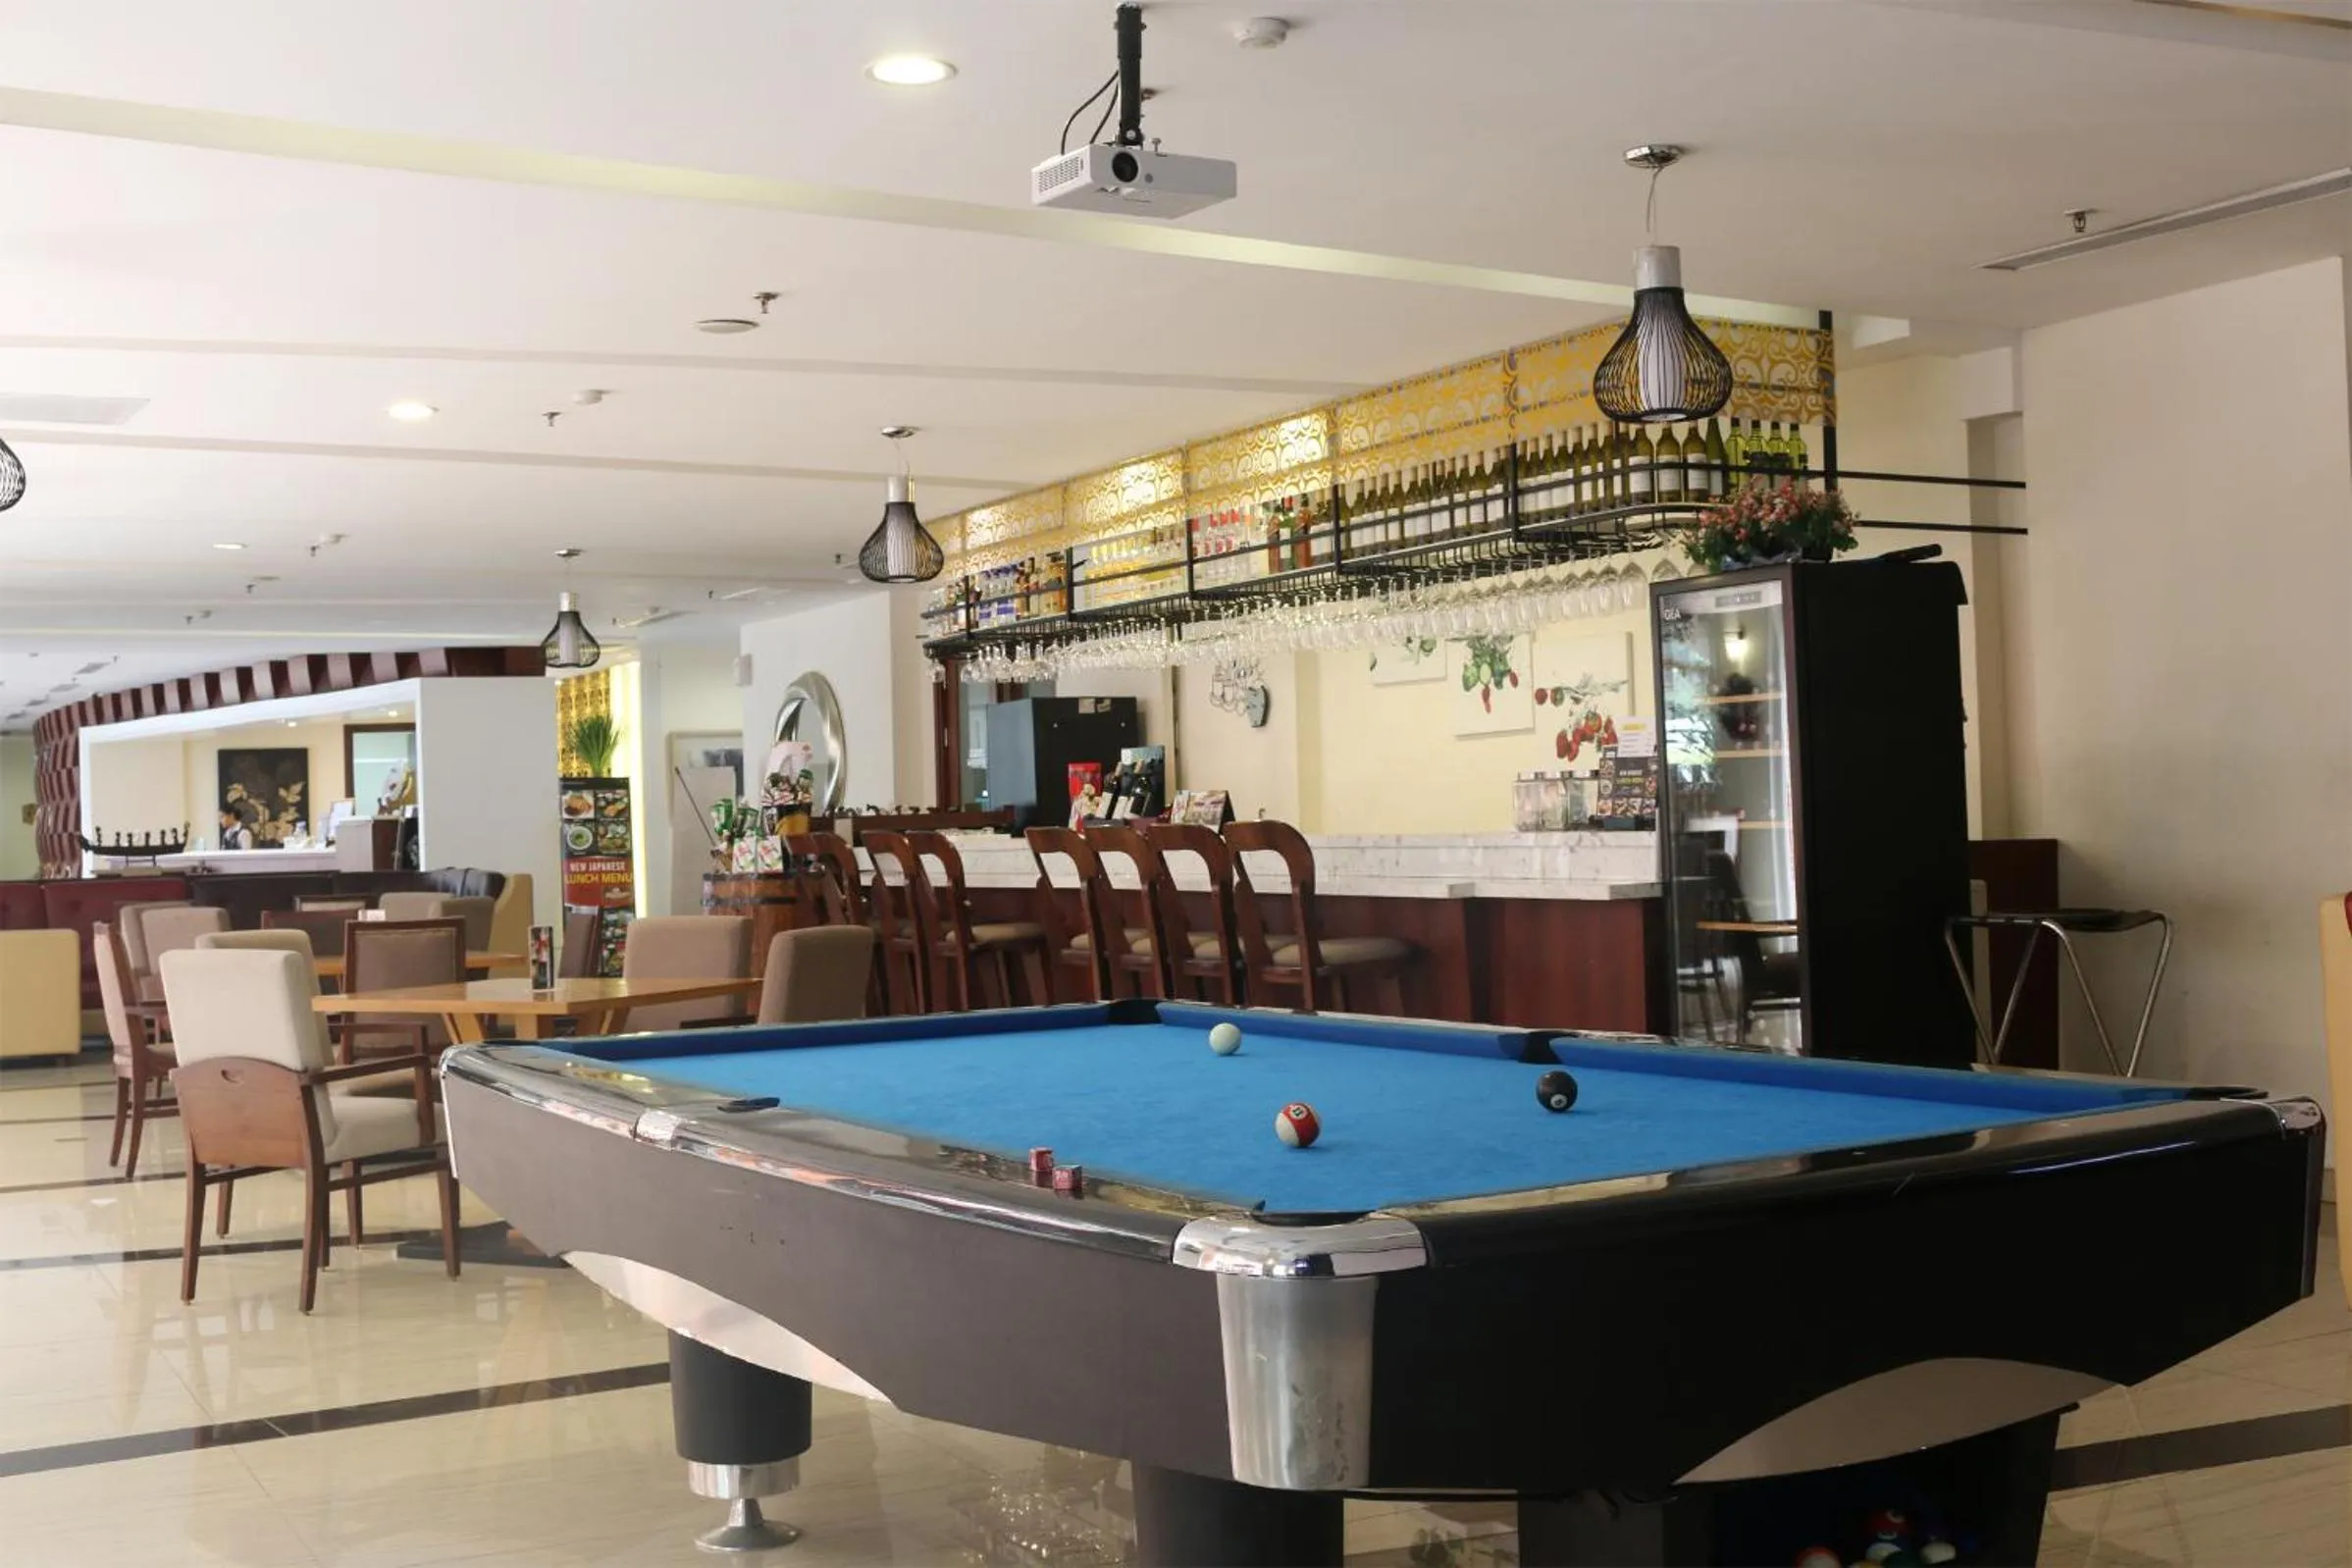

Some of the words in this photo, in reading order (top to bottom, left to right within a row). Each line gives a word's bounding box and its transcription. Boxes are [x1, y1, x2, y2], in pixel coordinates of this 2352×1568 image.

[569, 862, 587, 872] NEW
[589, 861, 626, 872] JAPANESE
[564, 872, 599, 884] LUNCH
[601, 871, 634, 884] MENU
